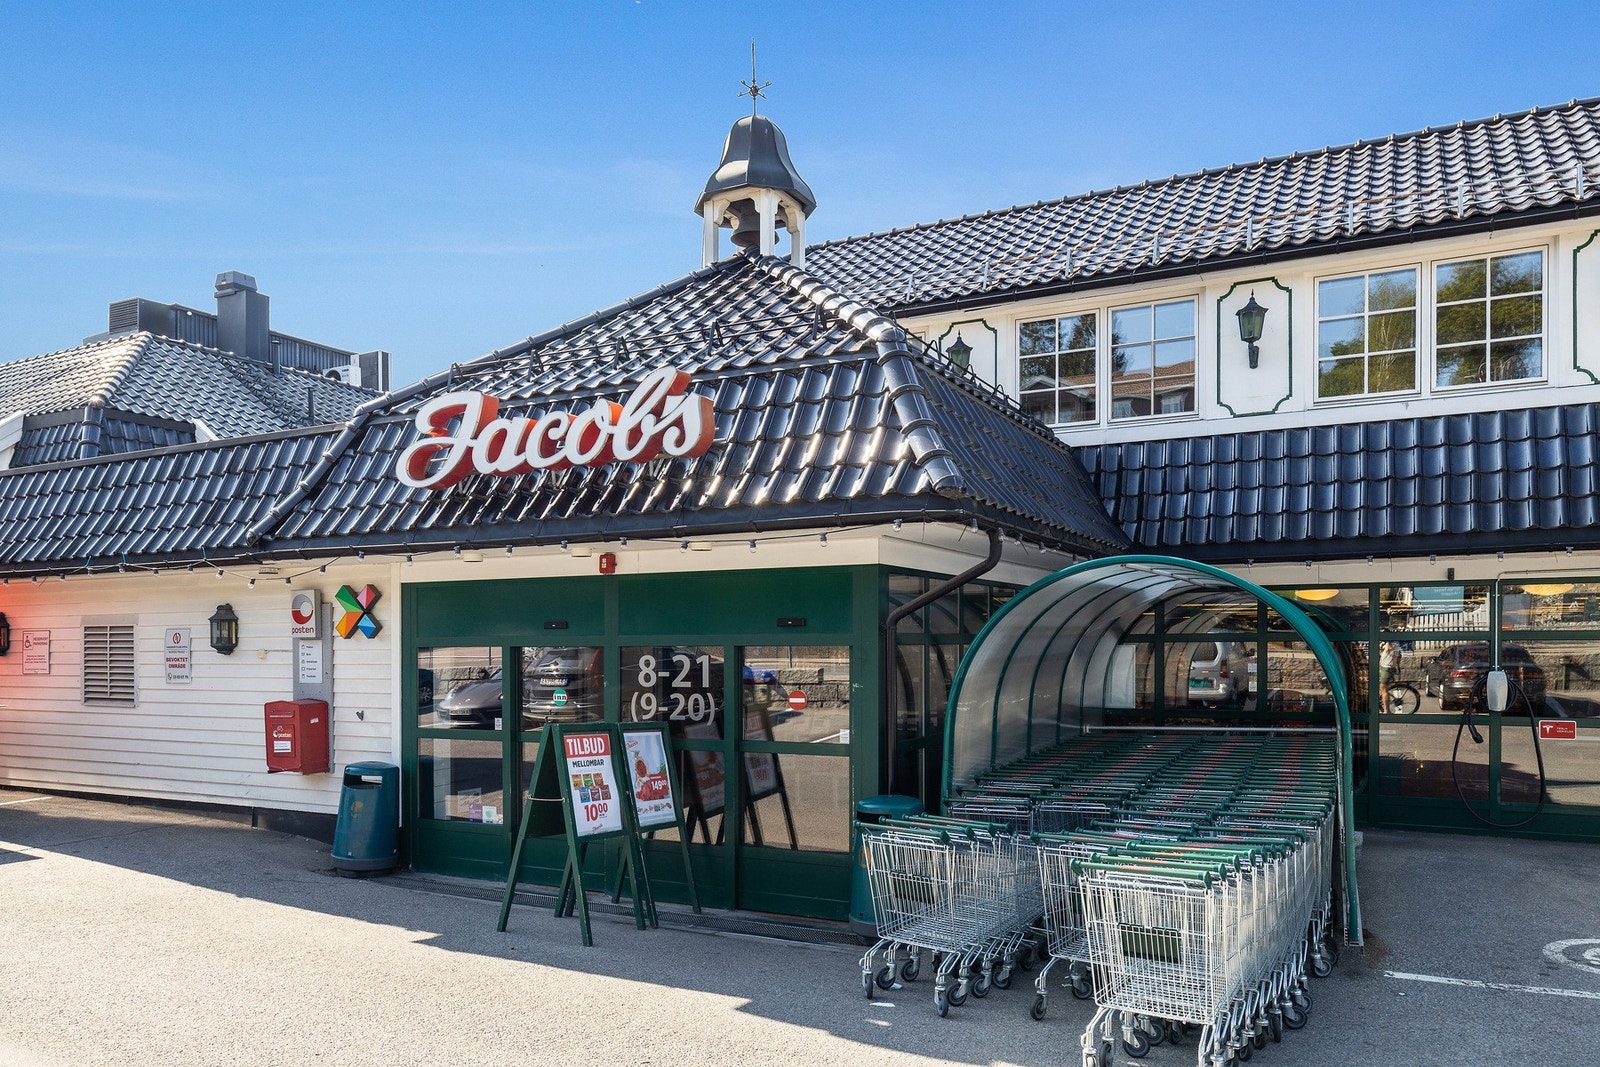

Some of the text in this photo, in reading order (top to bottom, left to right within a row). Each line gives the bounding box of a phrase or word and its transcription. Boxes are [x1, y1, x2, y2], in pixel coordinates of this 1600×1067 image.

[396, 365, 712, 490] Jacob's
[637, 654, 711, 688] 8-21
[630, 692, 716, 726] (9-20)
[566, 737, 605, 755] TILBUD
[572, 759, 605, 768] MELLOMBAR
